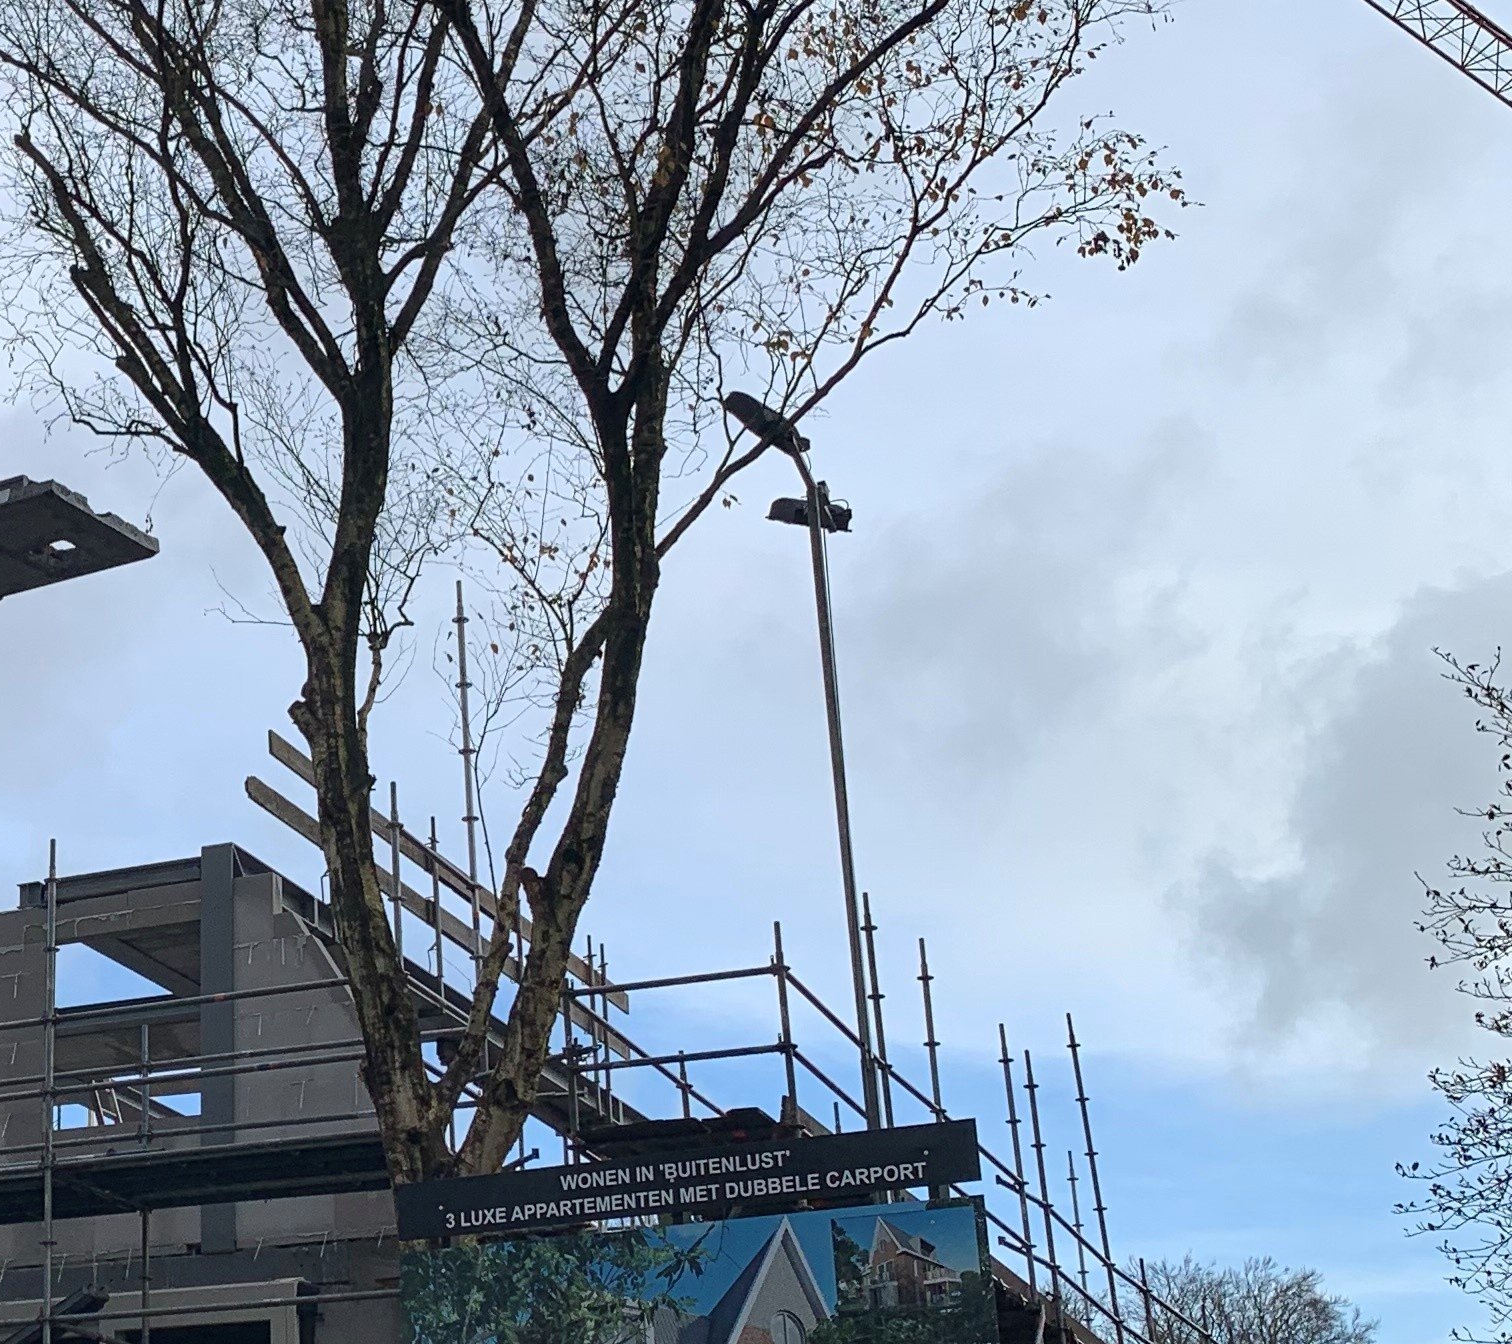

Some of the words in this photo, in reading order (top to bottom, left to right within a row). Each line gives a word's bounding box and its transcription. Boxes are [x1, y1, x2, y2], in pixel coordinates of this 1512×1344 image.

[444, 1210, 457, 1230] 3
[460, 1206, 507, 1228] LUXE
[510, 1191, 675, 1223] APPARTEMENTEN
[679, 1183, 721, 1204] MET
[724, 1173, 821, 1200] DUBBELE
[826, 1161, 928, 1189] CARPORT
[559, 1167, 631, 1192] WONEN
[635, 1164, 655, 1183] IN
[659, 1150, 791, 1183] 'BUITENLUST'
